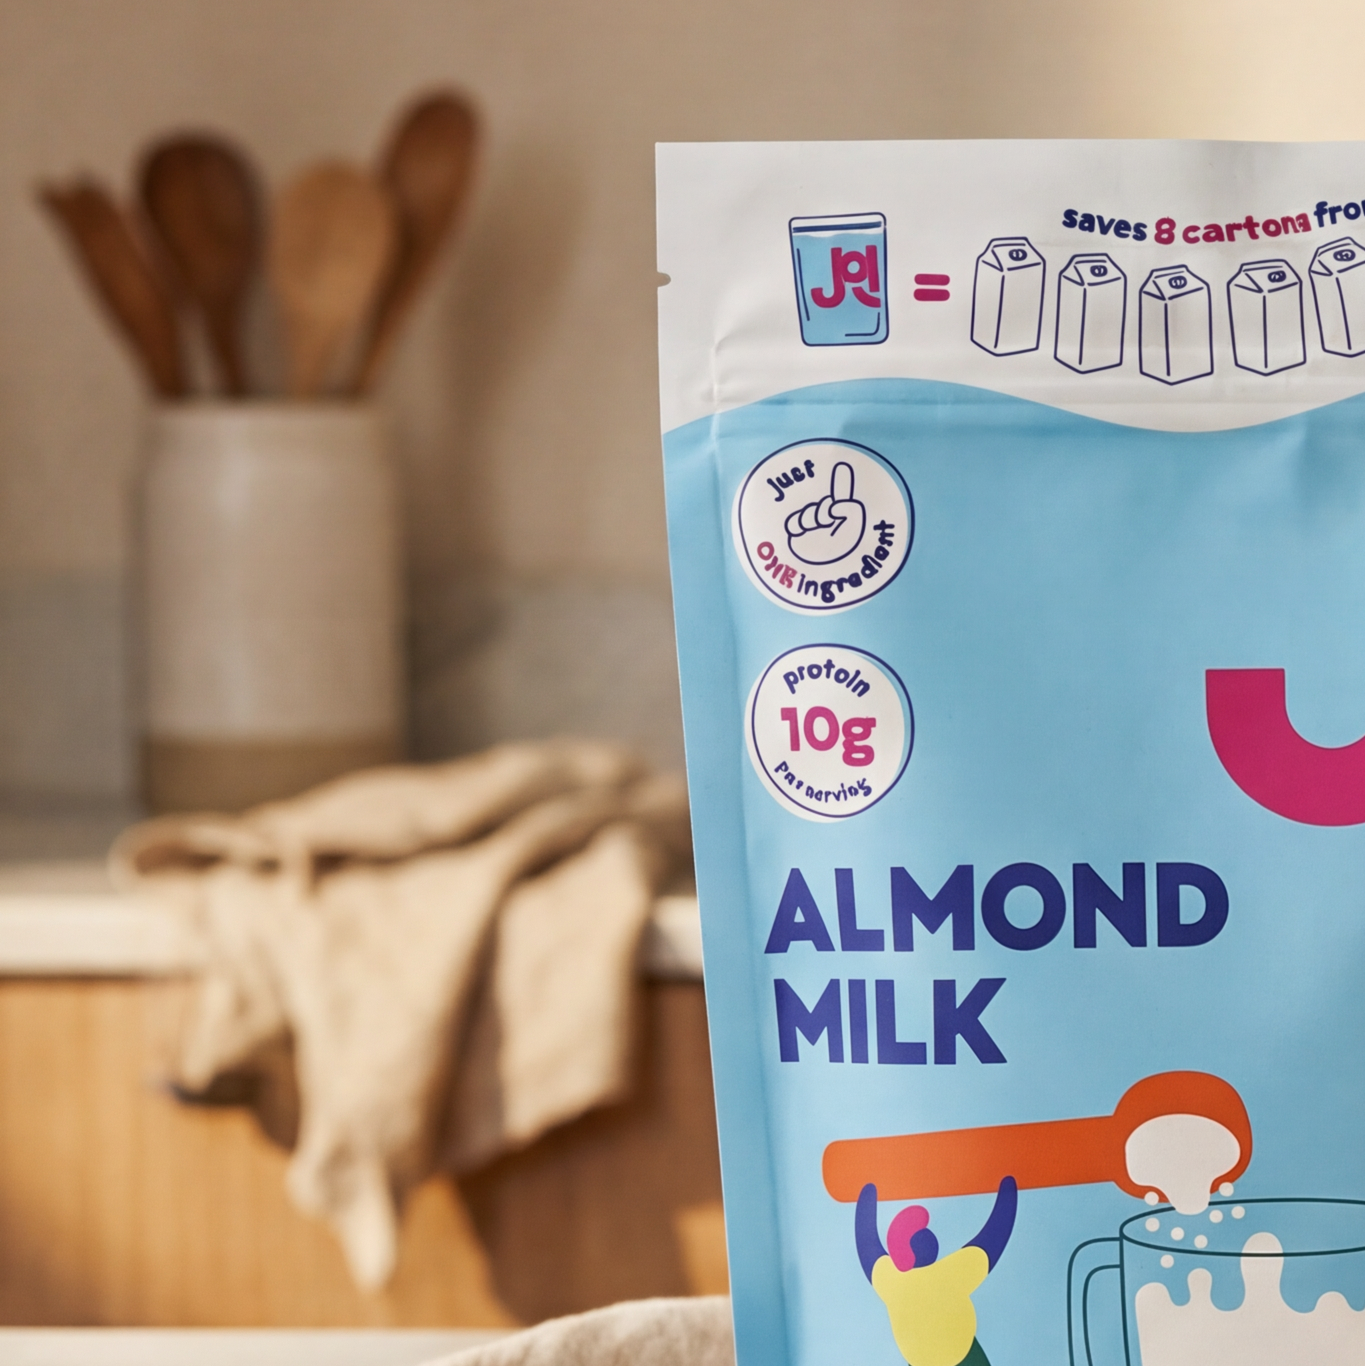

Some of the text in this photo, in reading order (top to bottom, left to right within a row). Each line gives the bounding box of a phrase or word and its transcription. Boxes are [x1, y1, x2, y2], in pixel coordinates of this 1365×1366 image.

[1062, 208, 1148, 241] saves
[1154, 217, 1177, 245] 8
[780, 706, 877, 767] 10g
[764, 861, 1230, 954] ALMOND
[773, 977, 1008, 1065] MILK
